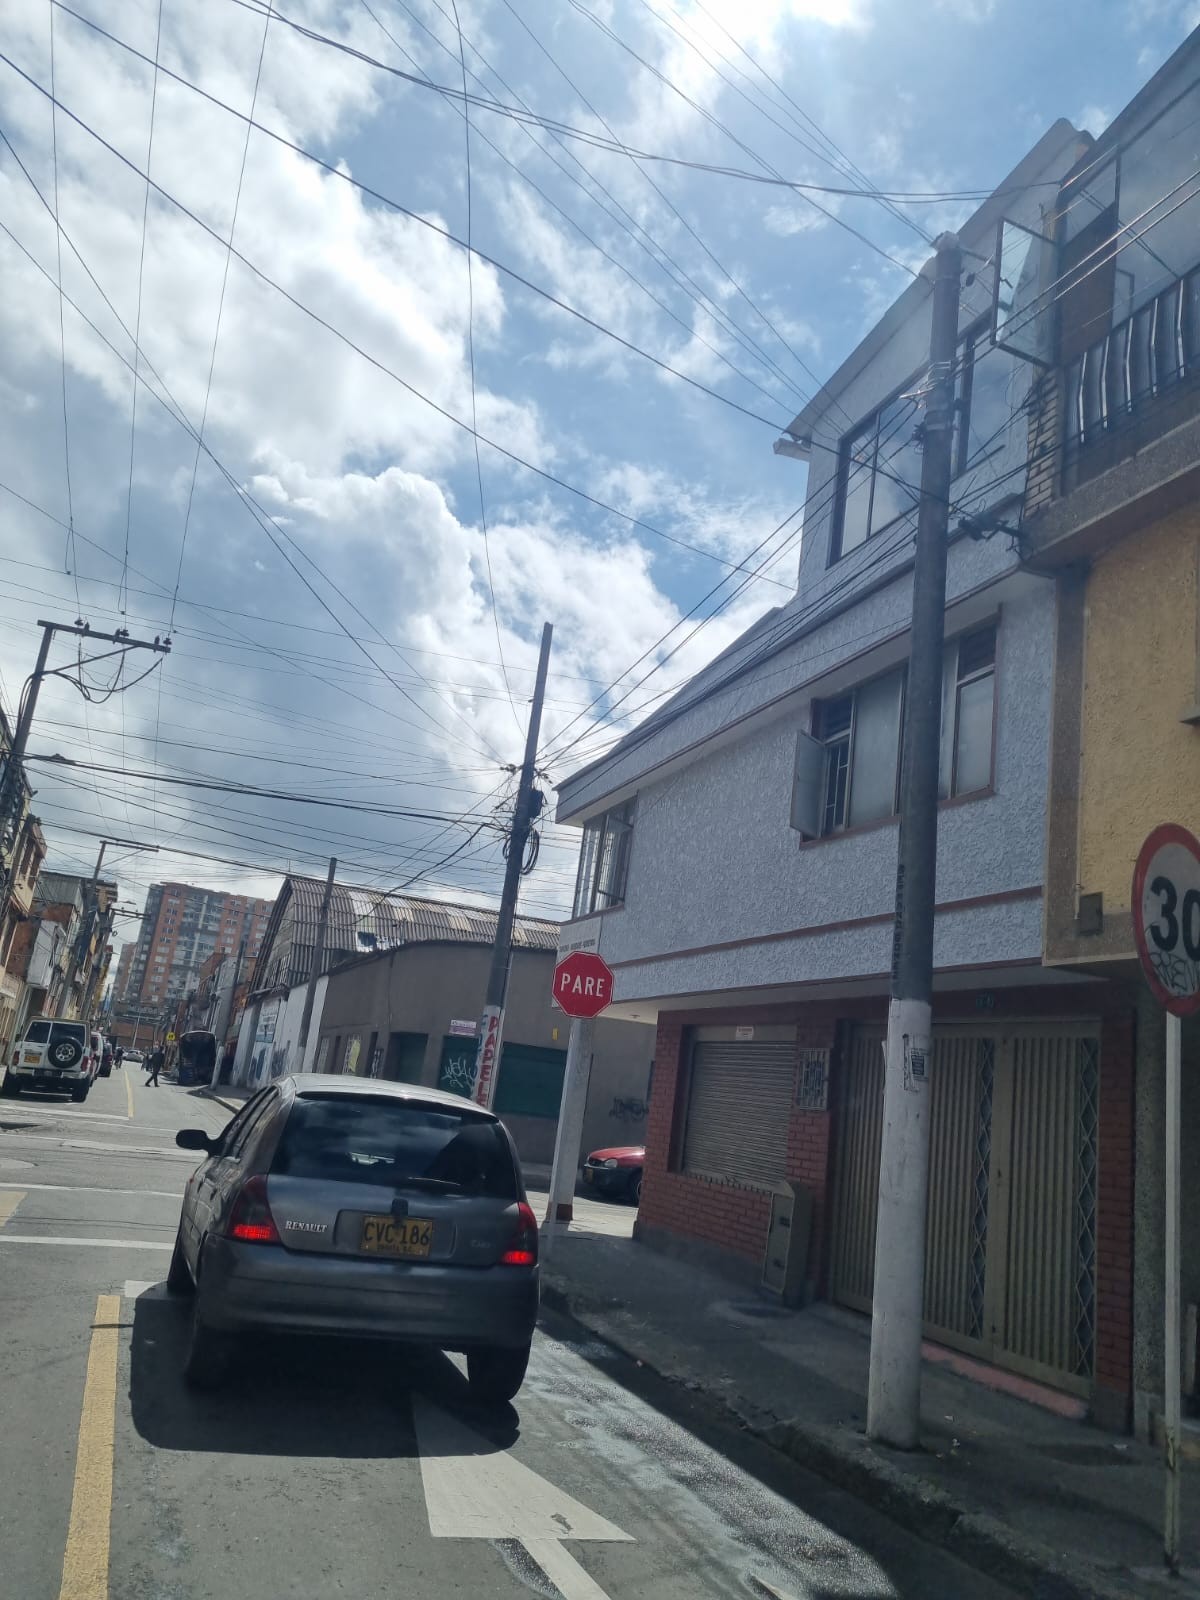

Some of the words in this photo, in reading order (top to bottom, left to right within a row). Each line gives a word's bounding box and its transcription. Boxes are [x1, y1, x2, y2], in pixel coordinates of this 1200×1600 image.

[1150, 876, 1200, 961] 30
[560, 973, 605, 998] PARE
[285, 1220, 328, 1233] RENAULT
[364, 1222, 394, 1244] CVC
[400, 1225, 431, 1246] 186
